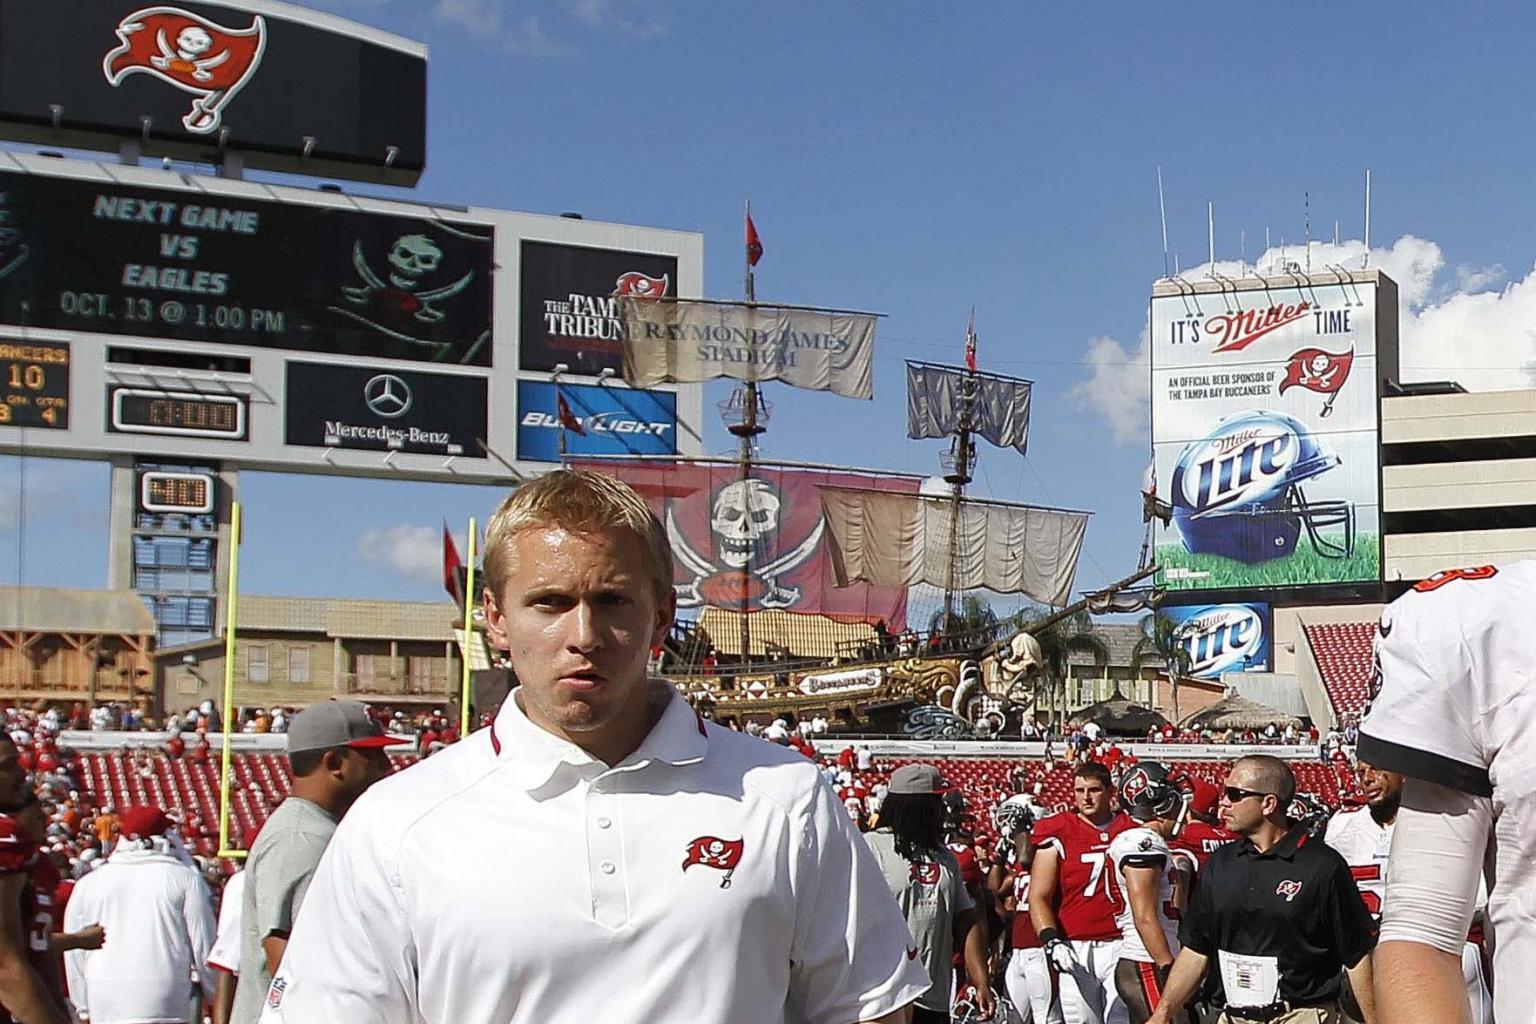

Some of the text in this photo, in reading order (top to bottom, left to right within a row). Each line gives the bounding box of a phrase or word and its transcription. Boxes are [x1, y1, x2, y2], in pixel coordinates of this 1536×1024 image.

[93, 195, 259, 234] NEXT GAME
[160, 233, 199, 258] VS
[122, 263, 230, 295] EAGLES
[60, 291, 285, 332] OCT. 13 @ 1:00 PM
[544, 300, 570, 314] THE
[645, 322, 850, 351] RAYMOND JAMES
[1171, 301, 1351, 350] IT'S Miller TIME
[697, 345, 798, 368] STADIUM
[8, 364, 46, 390] 10
[1168, 371, 1275, 388] AN OFFICIAL BEER SPONSOR OF
[1169, 384, 1272, 400] THE TAMPA BAY BUCCANEERS
[325, 421, 449, 443] Mercedes-Benz
[594, 418, 671, 436] LIGHT
[1212, 428, 1262, 454] Miller
[1193, 432, 1291, 508] Lite
[1080, 852, 1112, 899] 7
